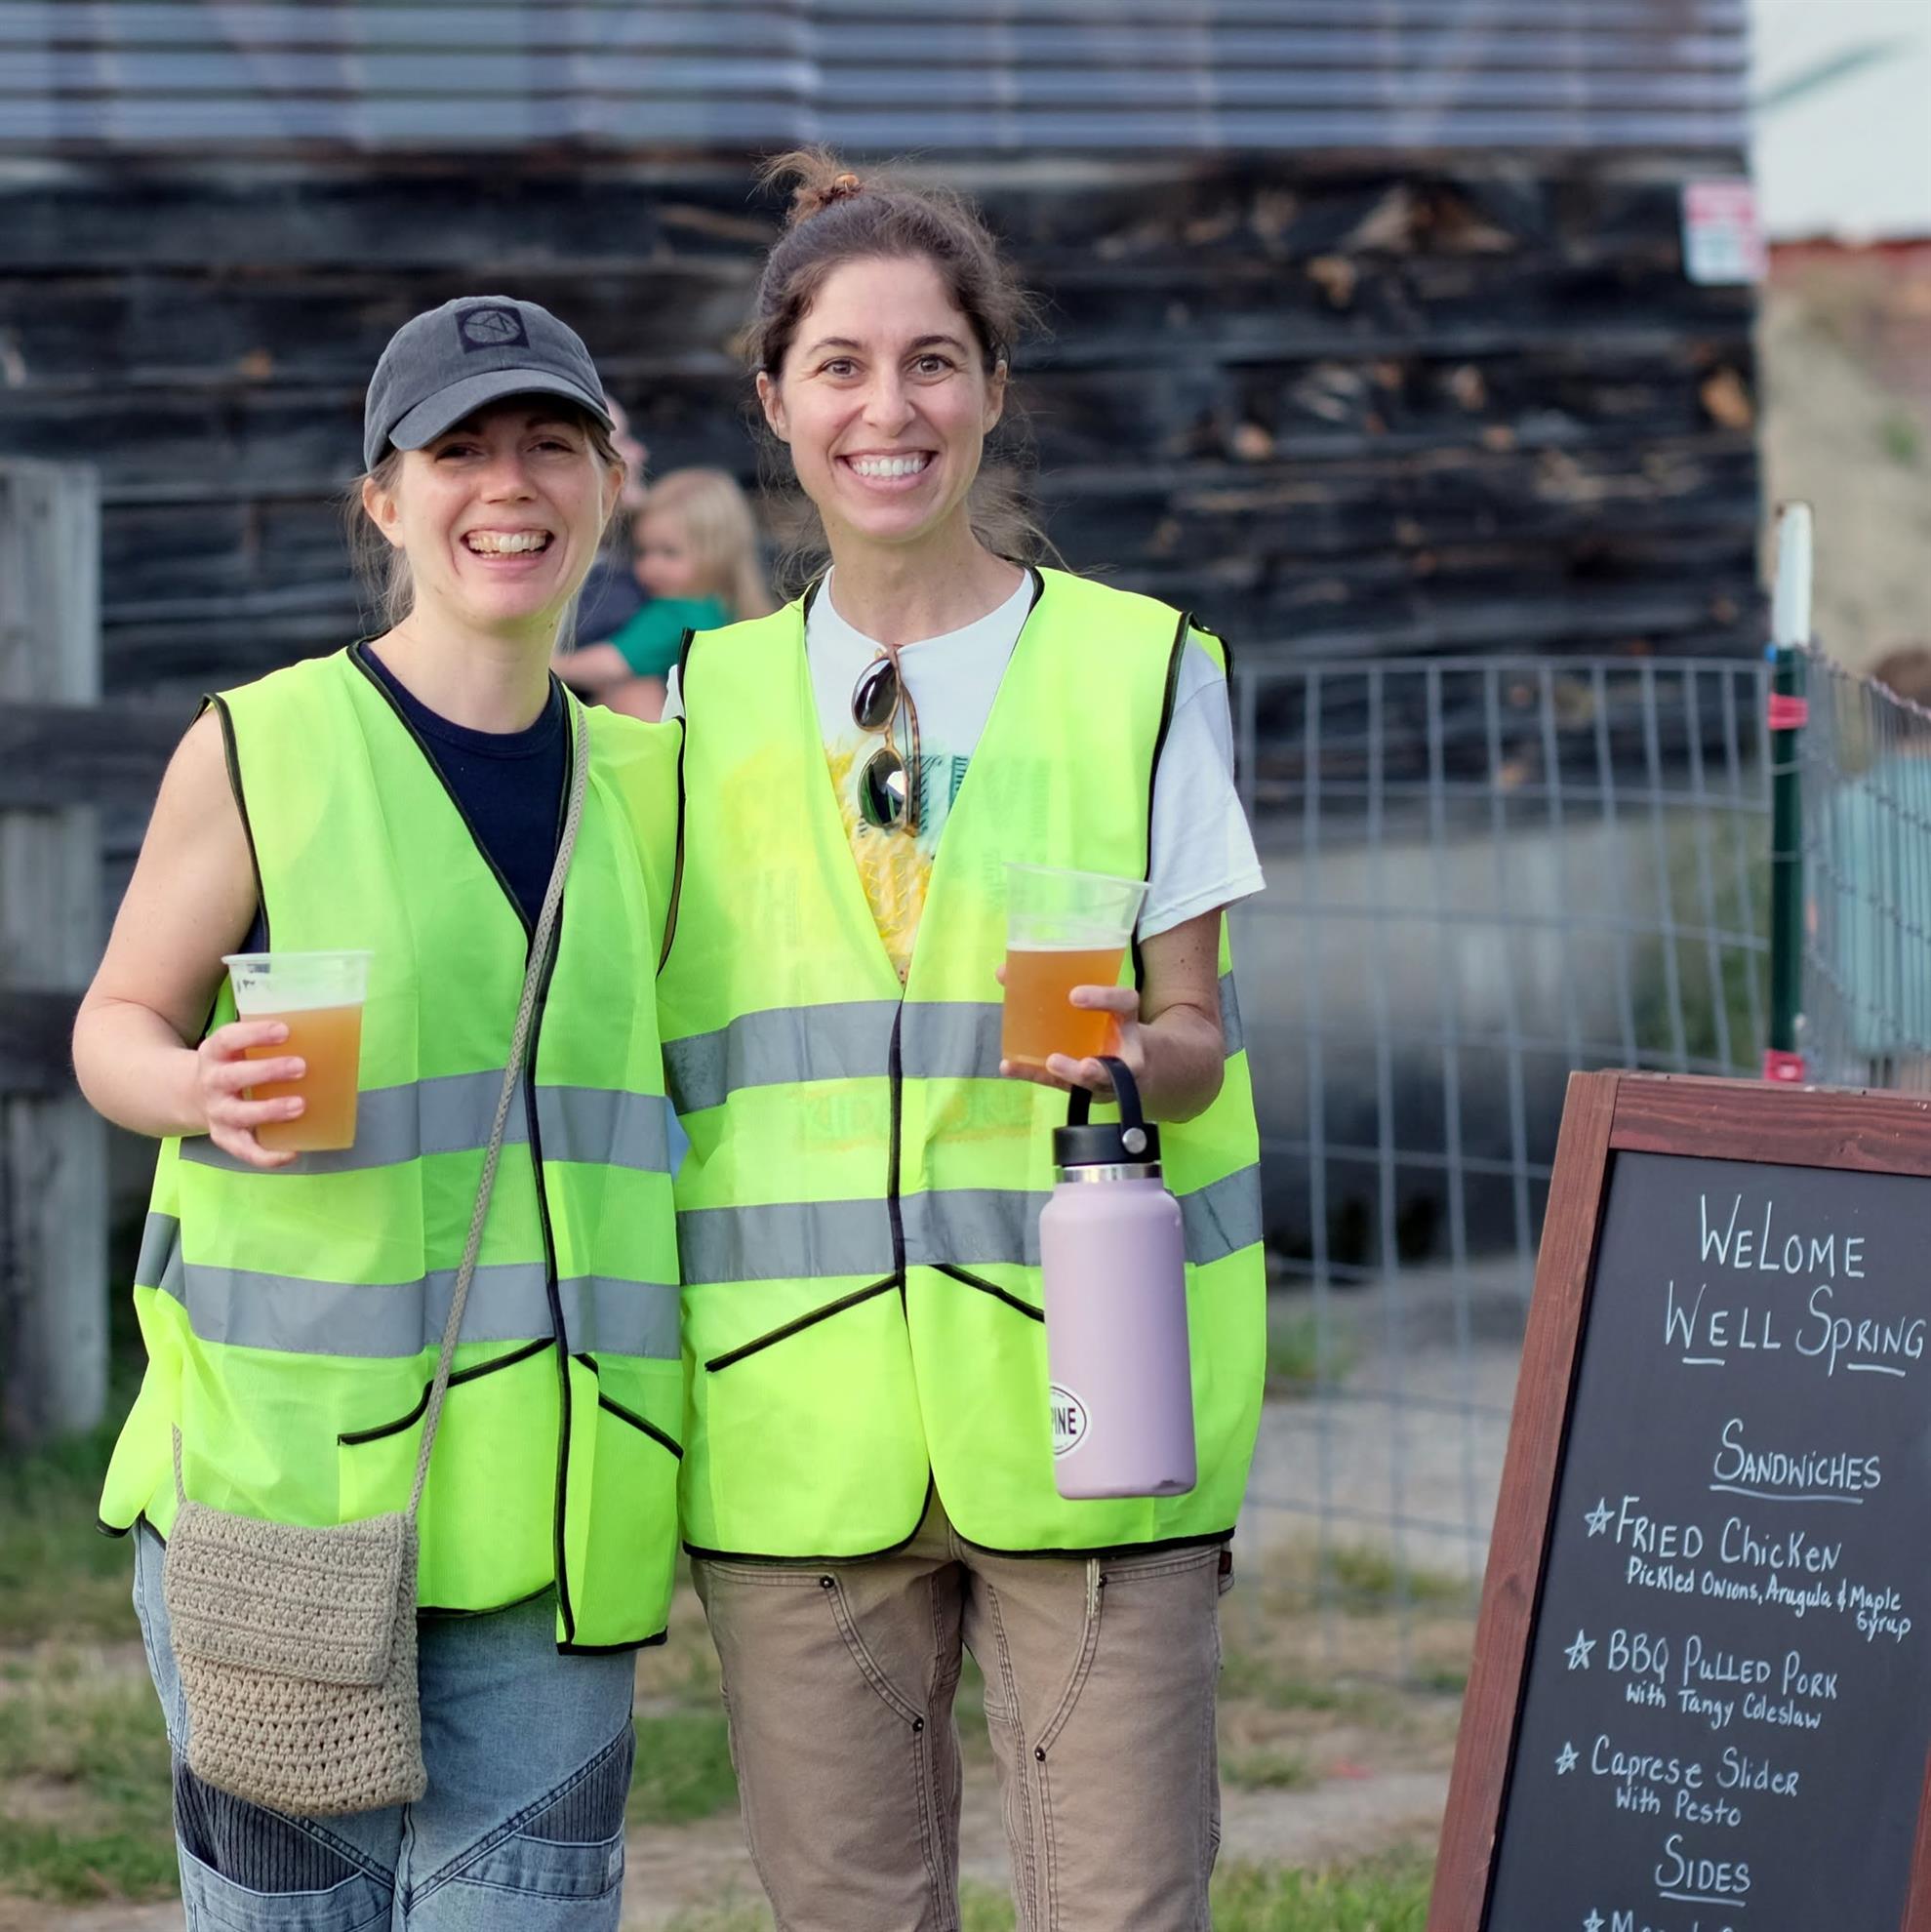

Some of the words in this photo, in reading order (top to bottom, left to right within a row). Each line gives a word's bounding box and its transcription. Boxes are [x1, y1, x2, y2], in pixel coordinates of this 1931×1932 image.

[1700, 1192, 1866, 1279] WELOME
[1665, 1279, 1782, 1349] WELL
[1616, 1494, 1704, 1558] FRIED
[1764, 1573, 1832, 1619] Arugula
[1848, 1585, 1902, 1614] Maple
[1856, 1610, 1912, 1644] Syrup
[1607, 1628, 1670, 1684] BBQ
[1782, 1650, 1838, 1700] PORK
[1677, 1688, 1735, 1731] Tangy
[1742, 1691, 1823, 1730] Coleslaw
[1590, 1733, 1704, 1790] Caprese
[1674, 1789, 1742, 1828] Pesto
[1654, 1833, 1751, 1894] SIDES
